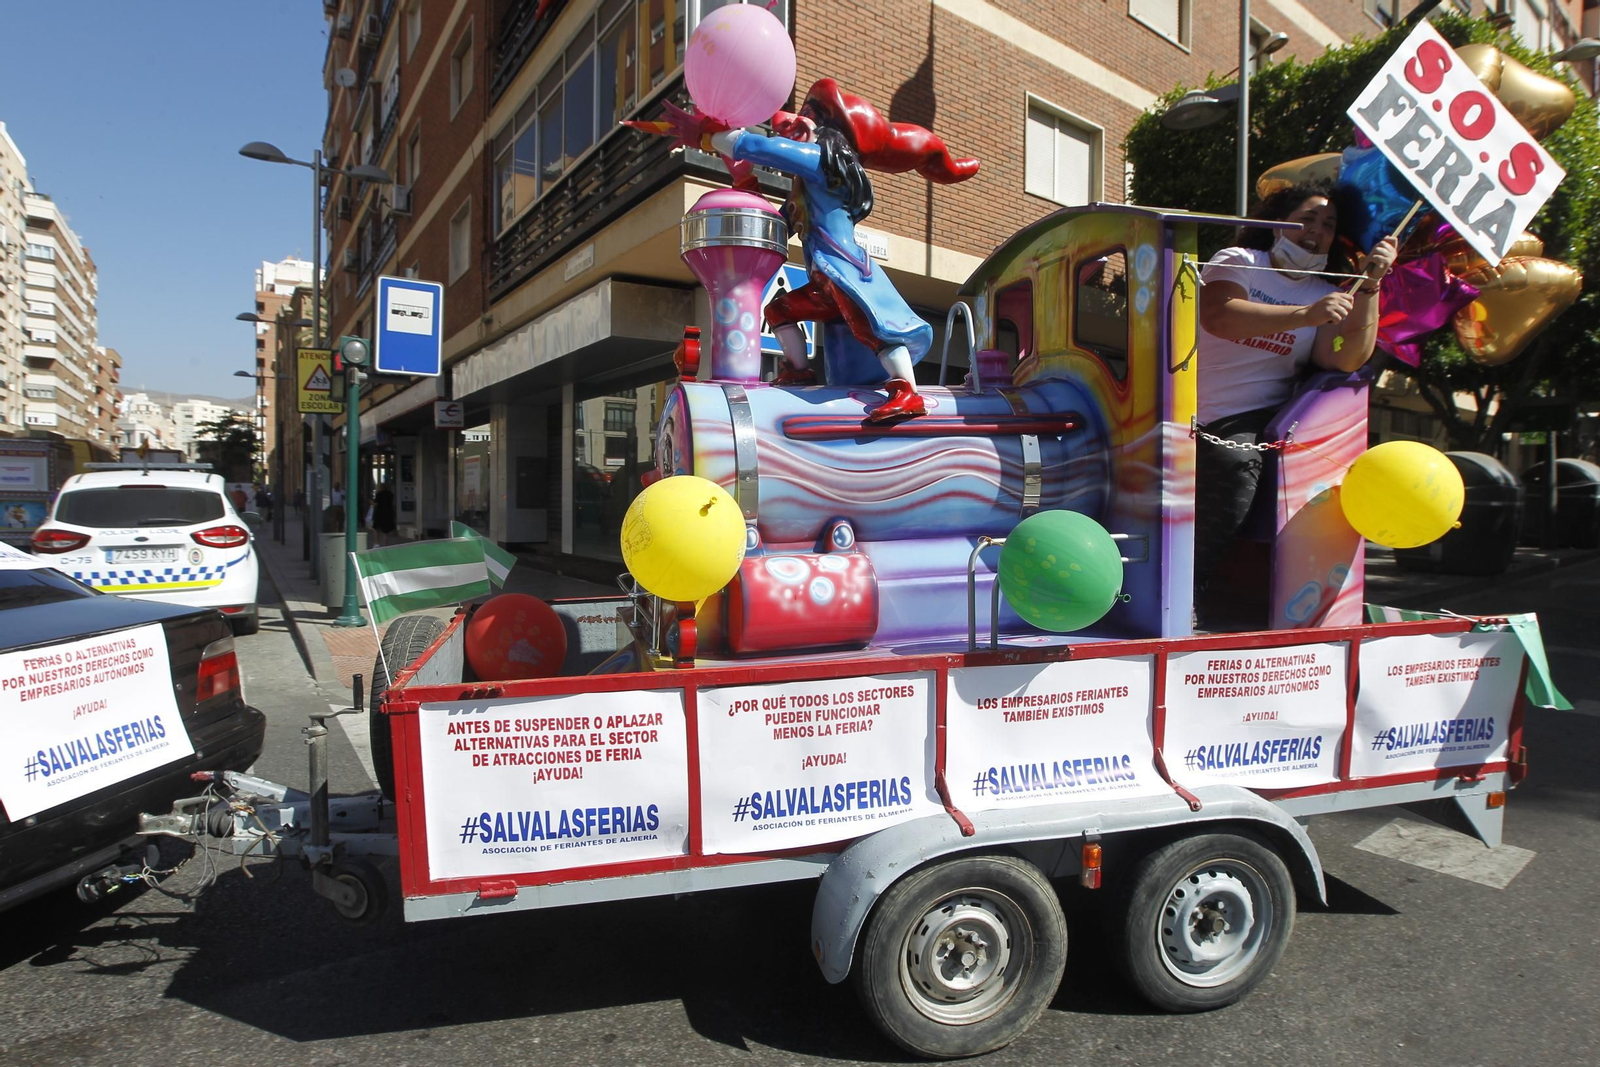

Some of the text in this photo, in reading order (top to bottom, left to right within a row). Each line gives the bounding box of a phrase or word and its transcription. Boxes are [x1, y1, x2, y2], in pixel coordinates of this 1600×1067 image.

[1358, 74, 1518, 255] FERIA
[870, 244, 887, 256] LORCA
[1259, 333, 1296, 346] ANTES
[300, 352, 332, 360] ATENCI
[301, 402, 340, 410] ESCOLAR
[60, 556, 92, 564] C-75
[116, 548, 175, 560] 7459 KYH
[24, 638, 136, 670] FERIAS O ALTERNATIVAS
[1207, 654, 1316, 672] FERIAS O ALTERNATIVAS
[2, 648, 154, 691] POR NUESTROS DERECHOS COMO
[1184, 665, 1332, 686] POR NUESTROS DERECHOS COMO
[1388, 658, 1500, 676] LOS EMPRESARIOS FERIANTES
[1438, 670, 1480, 684] EXISTIMOS
[20, 678, 91, 702] EMPRESARIOS
[978, 686, 1128, 710] LOS EMPRESARIOS FERIANTES
[1198, 680, 1320, 699] EMPRESARIOS AUTÓNOMOS
[73, 699, 108, 720] ¡AYUDA!
[728, 685, 914, 716] ¿POR QUÉ TODOS LOS SECTORES
[765, 704, 880, 726] PUEDEN FUNCIONAR
[1003, 702, 1104, 722] TAMBIÉN EXISTIMOS
[448, 712, 663, 735] ANTES DE SUSPENDER O APLAZAR
[774, 720, 874, 740] MENOS LA FERIA?
[454, 730, 658, 752] ALTERNATIVAS PARA EL SECTOR
[1372, 716, 1494, 752] #SALVALASFERIAS
[24, 715, 166, 782] #SALVALASFERIAS
[472, 748, 642, 767] DE ATRACCIONES DE FERIA
[1184, 736, 1322, 771] #SALVALASFERIAS
[1425, 746, 1456, 754] FERIANTES
[100, 753, 134, 769] FERIANTES
[802, 752, 847, 770] ¡AYUDA!
[533, 767, 583, 784] ¡AYUDA!
[972, 754, 1136, 796] #SALVALASFERIAS
[1248, 767, 1280, 776] FERIANTES
[732, 776, 912, 822] #SALVALASFERIAS
[1055, 786, 1096, 796] FERIANTES
[459, 804, 660, 844] #SALVALASFERIAS
[805, 818, 816, 826] DE
[818, 814, 863, 826] FERIANTES
[865, 812, 876, 820] DE
[540, 844, 552, 852] DE
[554, 840, 604, 850] FERIANTES
